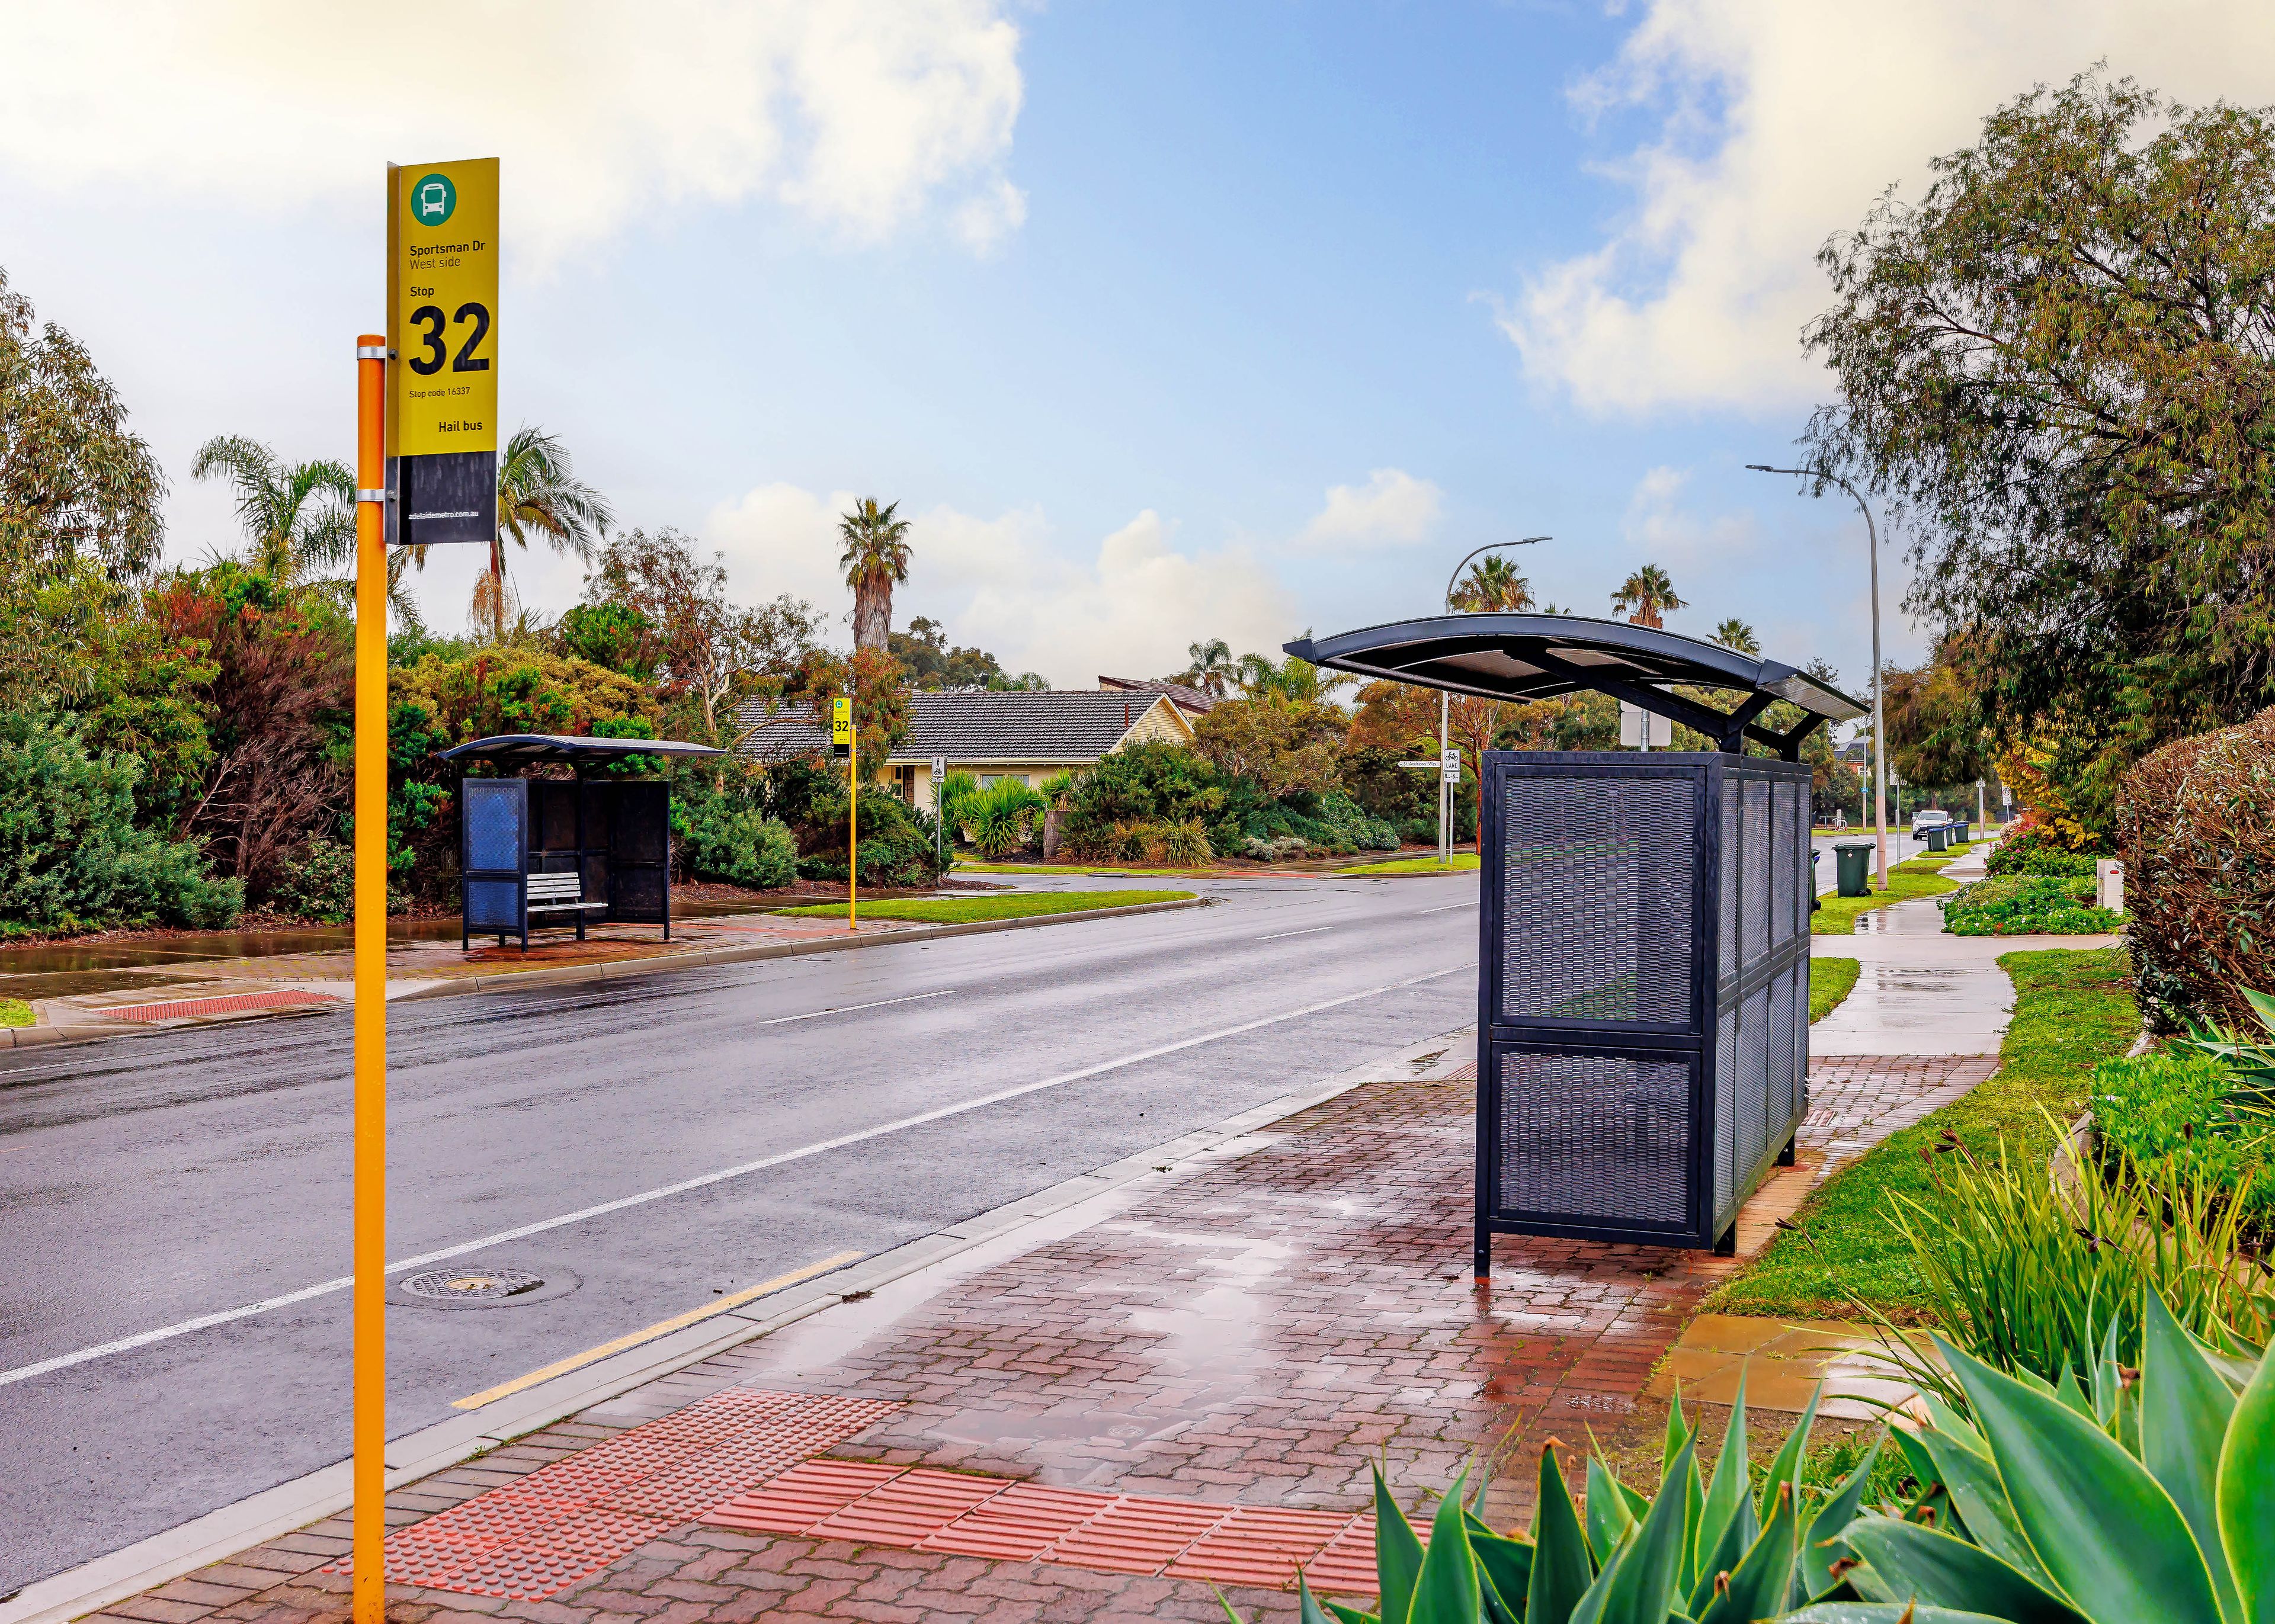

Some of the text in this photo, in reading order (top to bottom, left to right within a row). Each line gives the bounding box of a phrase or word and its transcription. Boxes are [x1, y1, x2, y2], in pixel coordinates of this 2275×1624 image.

[409, 240, 486, 258] Sportsman Dr
[409, 256, 461, 269] West side
[410, 286, 434, 298] Stop
[409, 302, 490, 375] 32
[409, 387, 470, 399] Stop code 16337
[439, 421, 483, 432] Hail bus
[408, 511, 479, 519] adelaidemetro.com.au
[835, 720, 848, 732] 32
